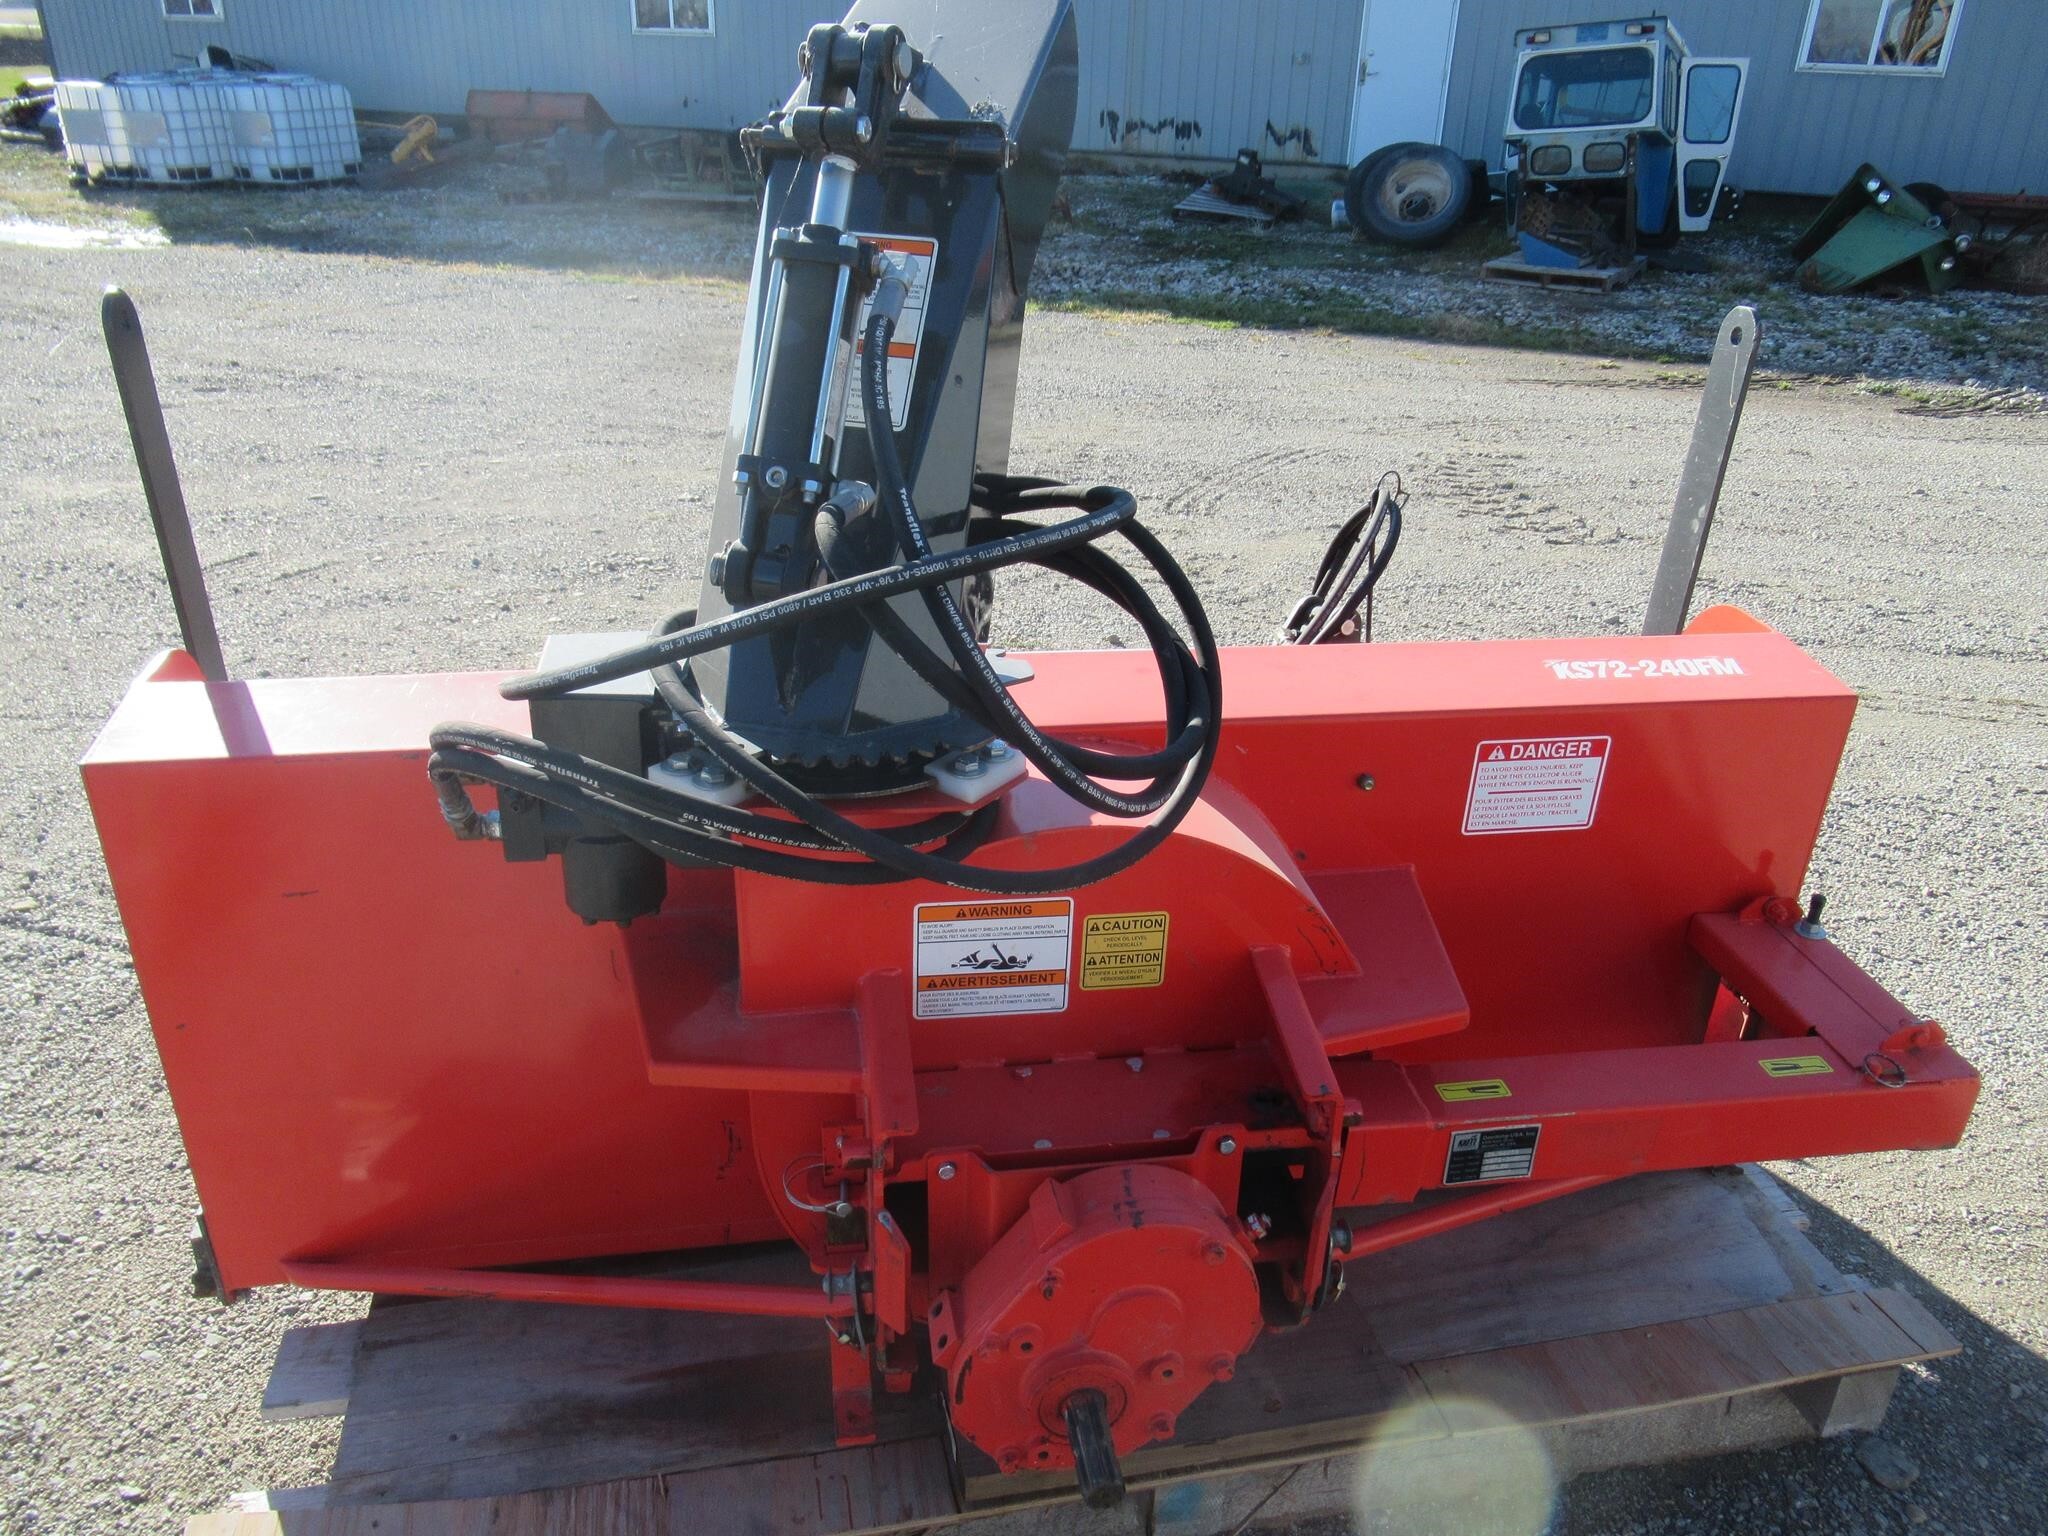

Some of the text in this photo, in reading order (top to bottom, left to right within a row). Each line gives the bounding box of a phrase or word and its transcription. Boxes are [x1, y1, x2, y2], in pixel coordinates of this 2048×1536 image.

[900, 487, 924, 548] Transflex
[1003, 542, 1021, 553] 2SN
[1022, 537, 1036, 546] 853
[979, 546, 1003, 559] DN10
[953, 554, 972, 567] SAE
[808, 592, 831, 606] BAR
[778, 603, 801, 615] 4800
[760, 610, 777, 622] PSI
[686, 627, 713, 644] MSHA
[720, 625, 730, 634] W
[659, 642, 674, 653] 195
[676, 636, 686, 647] IC
[1547, 656, 1745, 680] KS72-240FM
[942, 597, 965, 631] DIN/EN
[961, 631, 974, 649] 853
[971, 648, 986, 669] 2SN
[984, 669, 1002, 693] DN10
[1003, 698, 1019, 717] SAE
[1087, 786, 1101, 800] BAR
[1509, 741, 1592, 759] DANGER
[543, 762, 600, 788] Transflex
[683, 812, 698, 822] 195
[701, 817, 711, 825] IC
[713, 822, 741, 834] MSHA
[968, 904, 1033, 918] WARNING
[1102, 918, 1163, 931] CAUTION
[1098, 952, 1160, 965] ATTENTION
[939, 972, 1057, 988] AVERTISSEMENT
